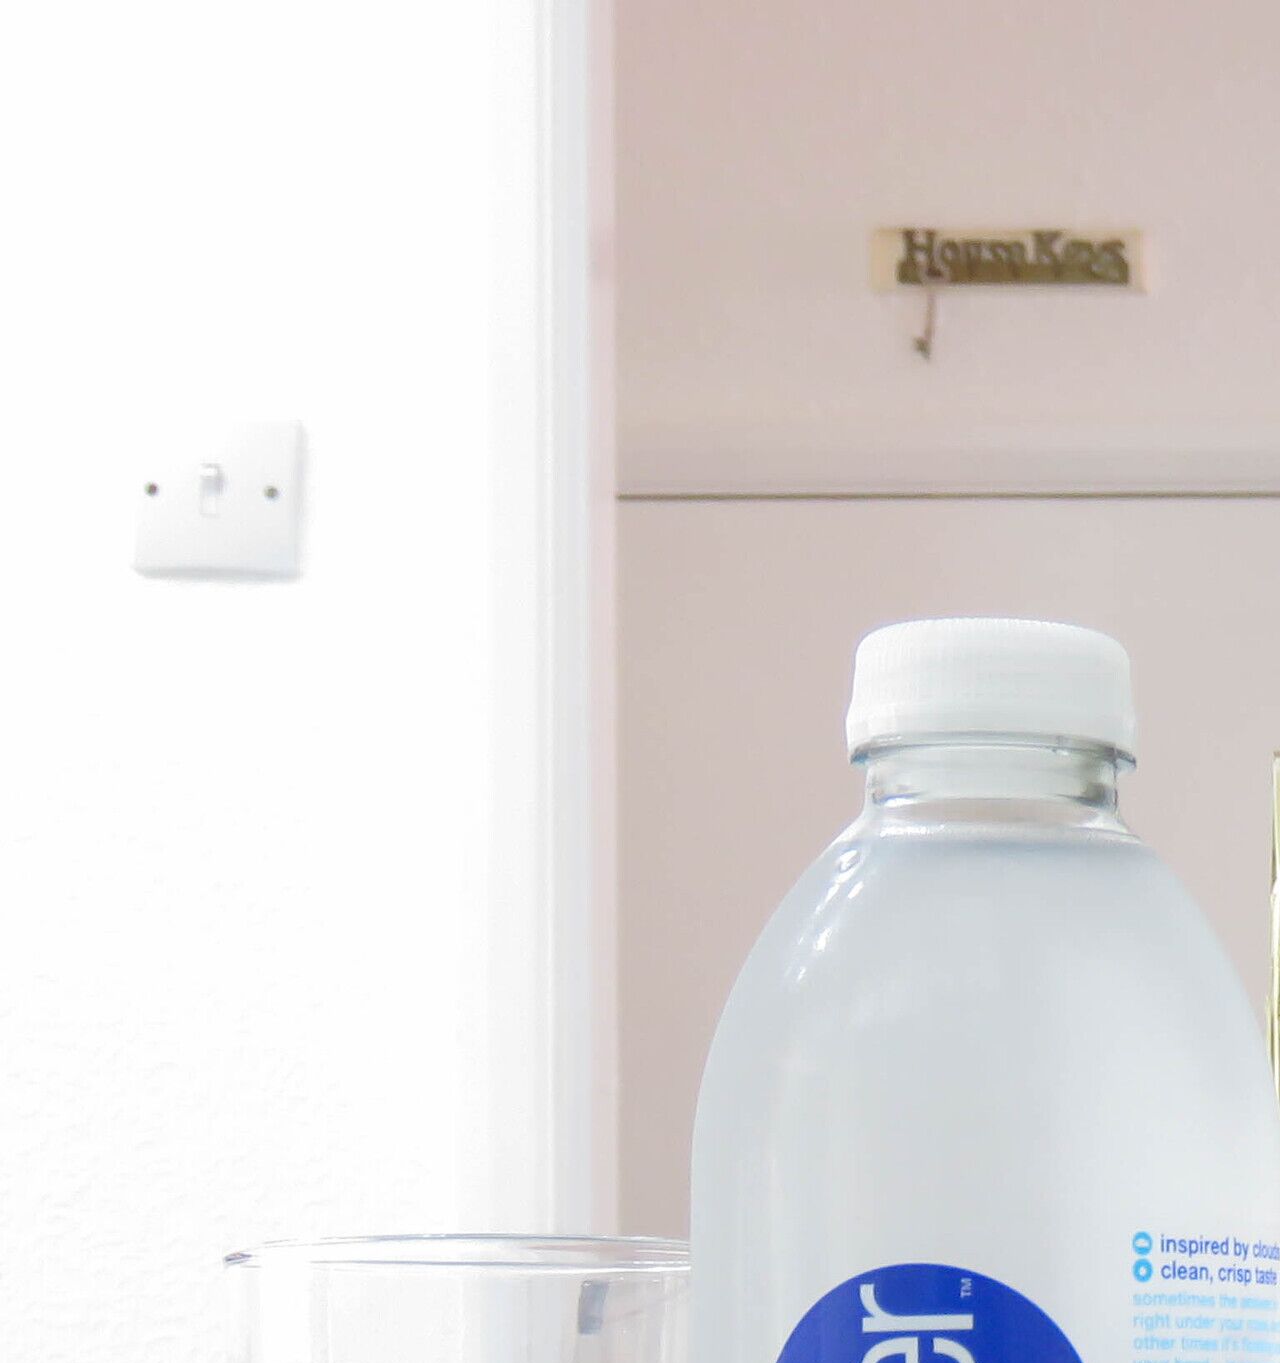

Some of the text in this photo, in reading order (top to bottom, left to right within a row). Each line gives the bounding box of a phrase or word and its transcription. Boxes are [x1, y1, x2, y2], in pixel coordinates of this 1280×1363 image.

[1160, 1235, 1229, 1257] inspired
[1233, 1238, 1249, 1261] by
[1160, 1261, 1214, 1285] clean,
[1218, 1264, 1251, 1287] crisp
